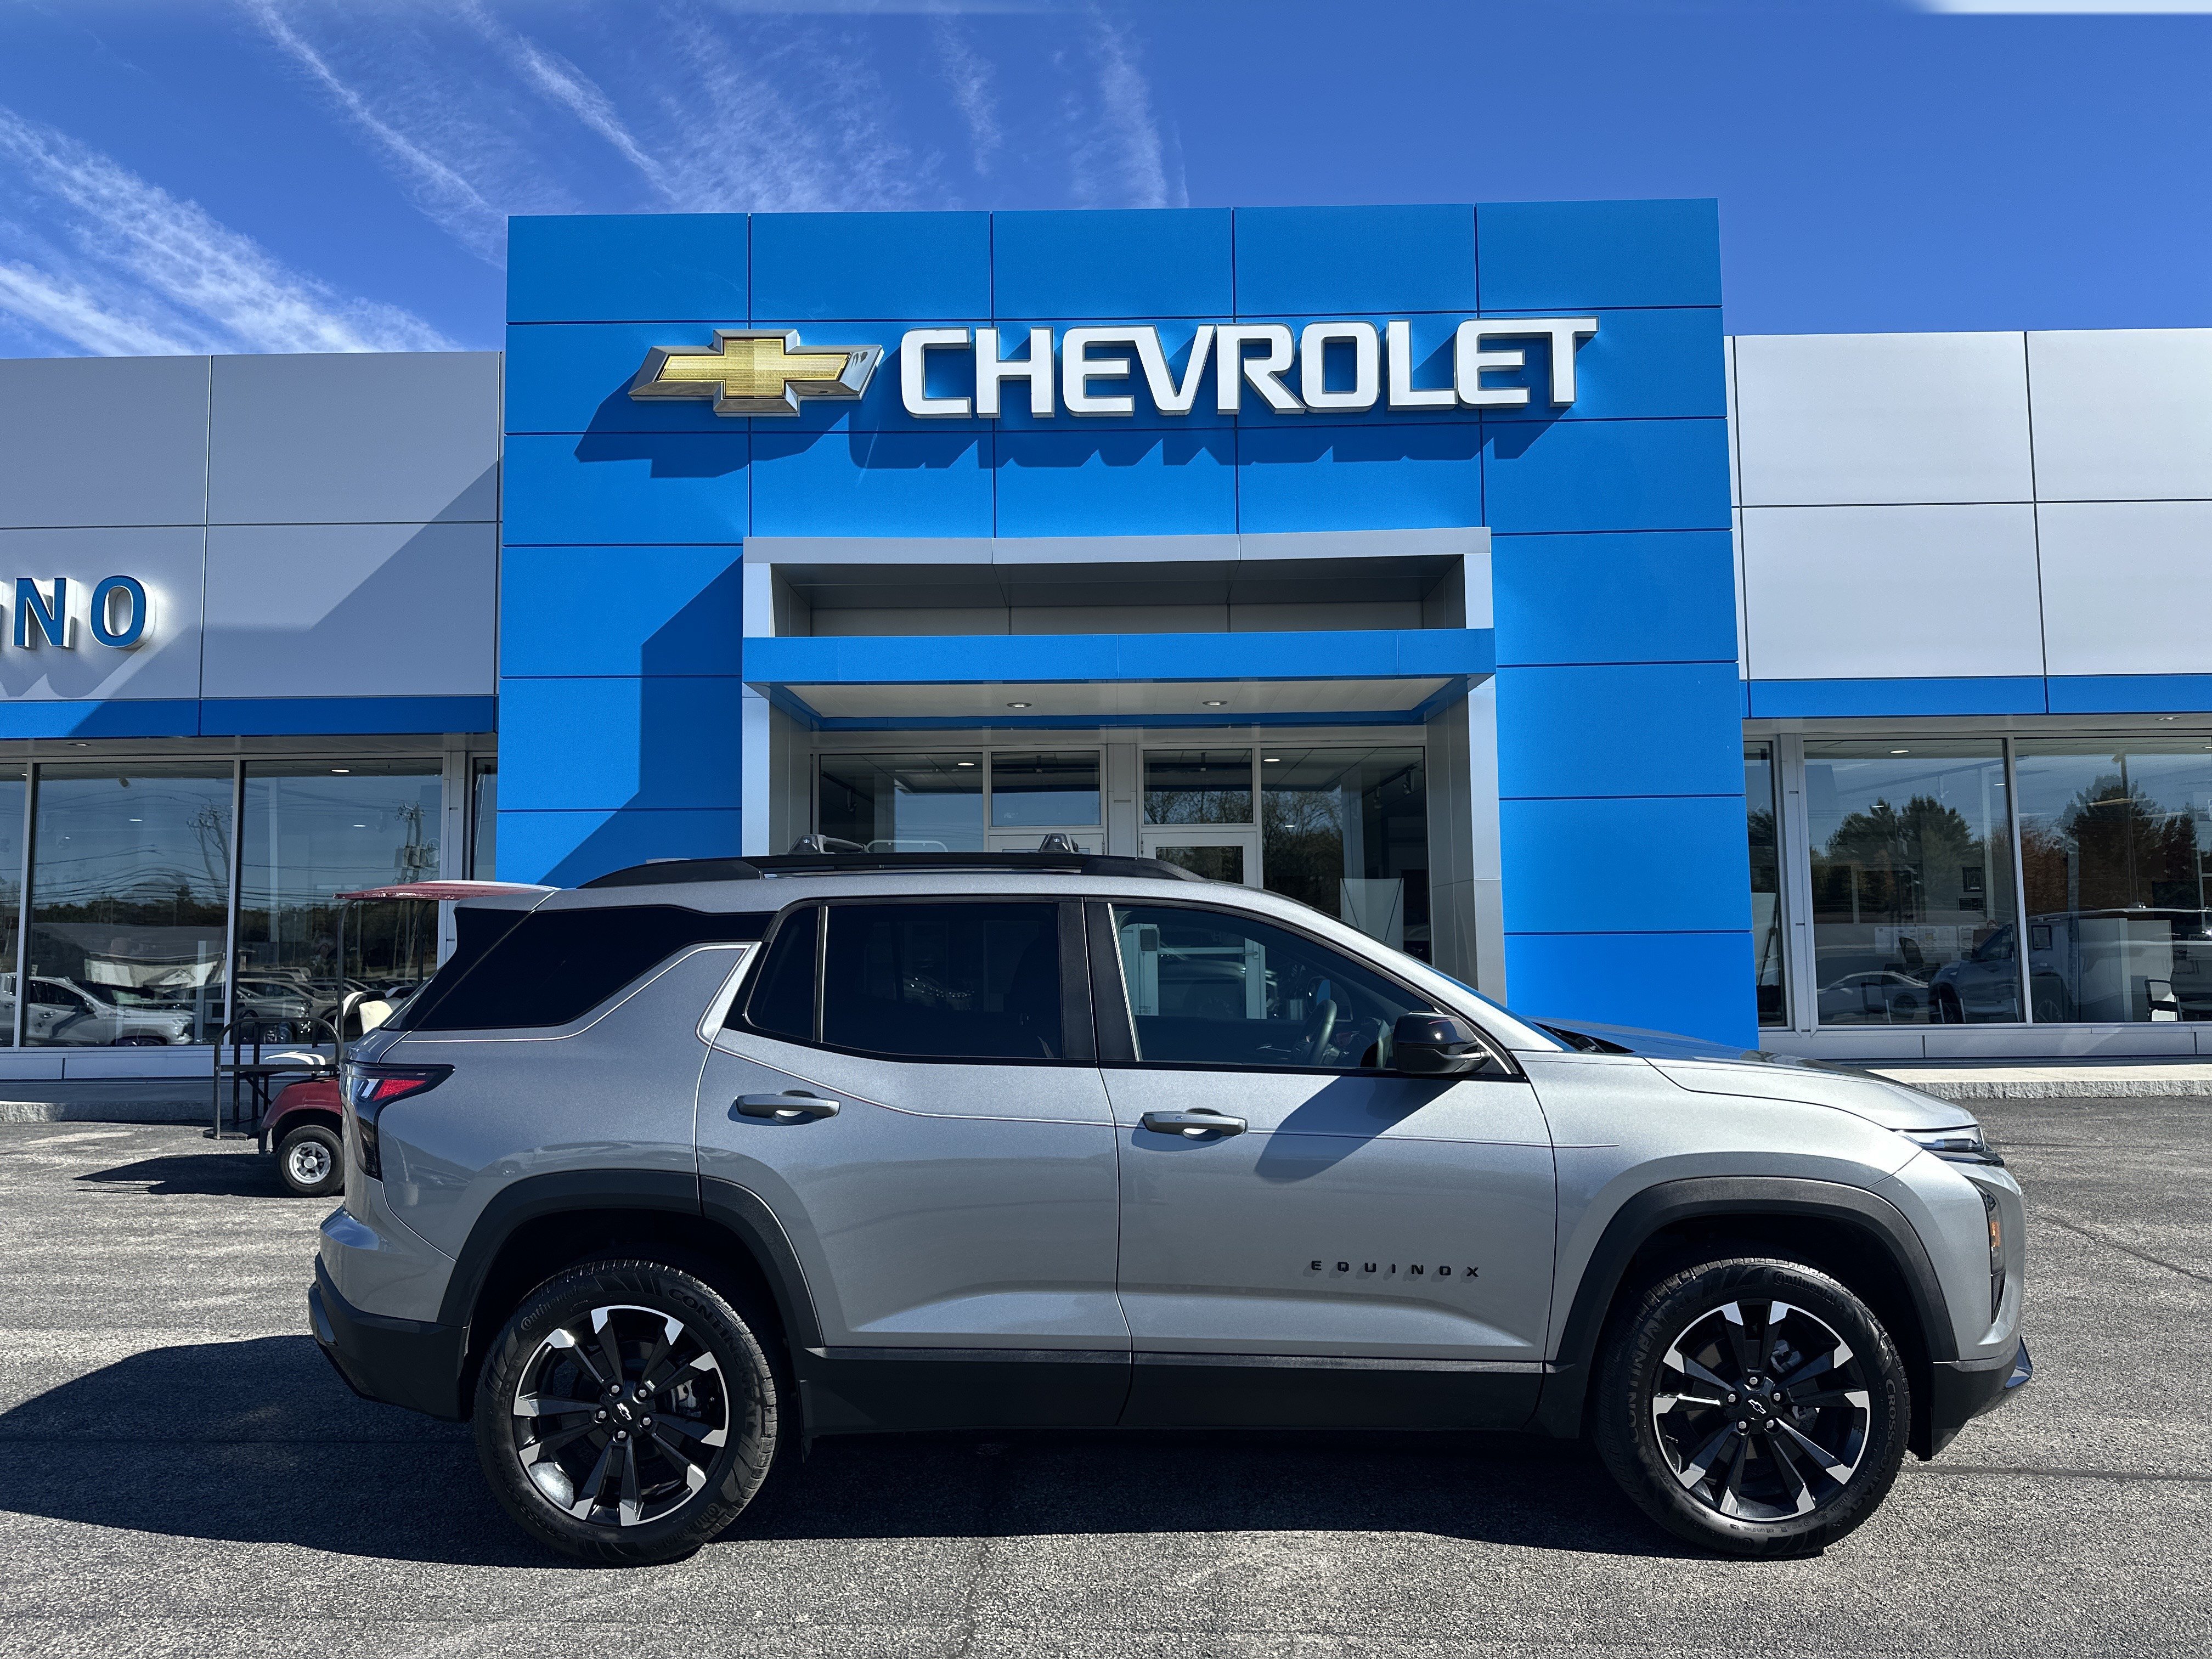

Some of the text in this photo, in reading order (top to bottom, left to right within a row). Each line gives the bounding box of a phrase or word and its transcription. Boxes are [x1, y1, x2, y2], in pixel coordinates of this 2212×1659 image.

[900, 316, 1599, 419] CHEVROLET
[0, 574, 156, 650] NO
[1310, 1260, 1480, 1278] EQUINOX
